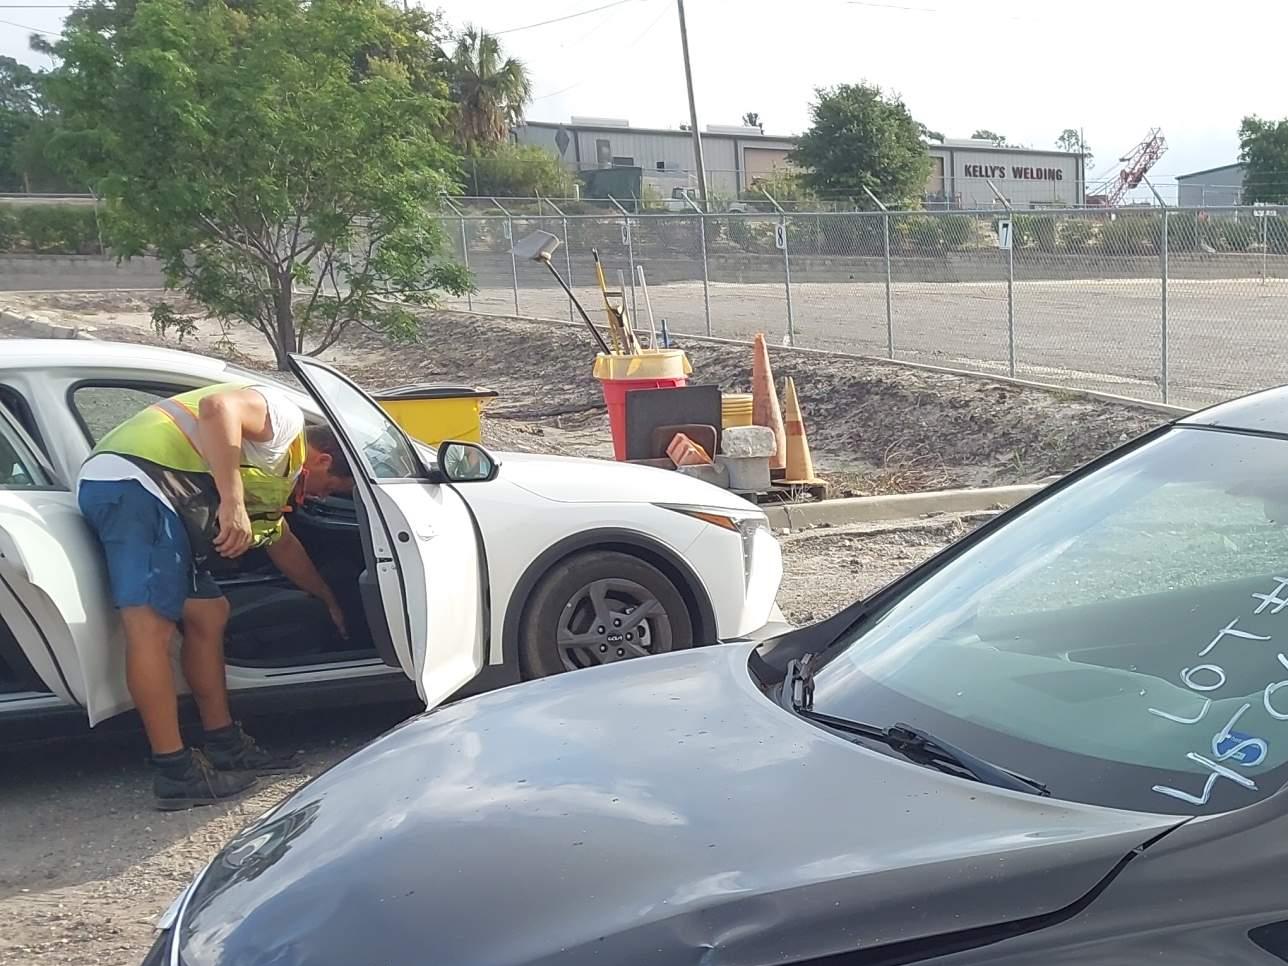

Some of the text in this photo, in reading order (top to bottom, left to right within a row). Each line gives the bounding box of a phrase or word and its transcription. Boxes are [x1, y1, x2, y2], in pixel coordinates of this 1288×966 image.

[964, 164, 1063, 181] KELLY'S WELDING
[777, 226, 784, 247] 8
[1002, 223, 1009, 247] 7
[1148, 616, 1273, 725] LOT
